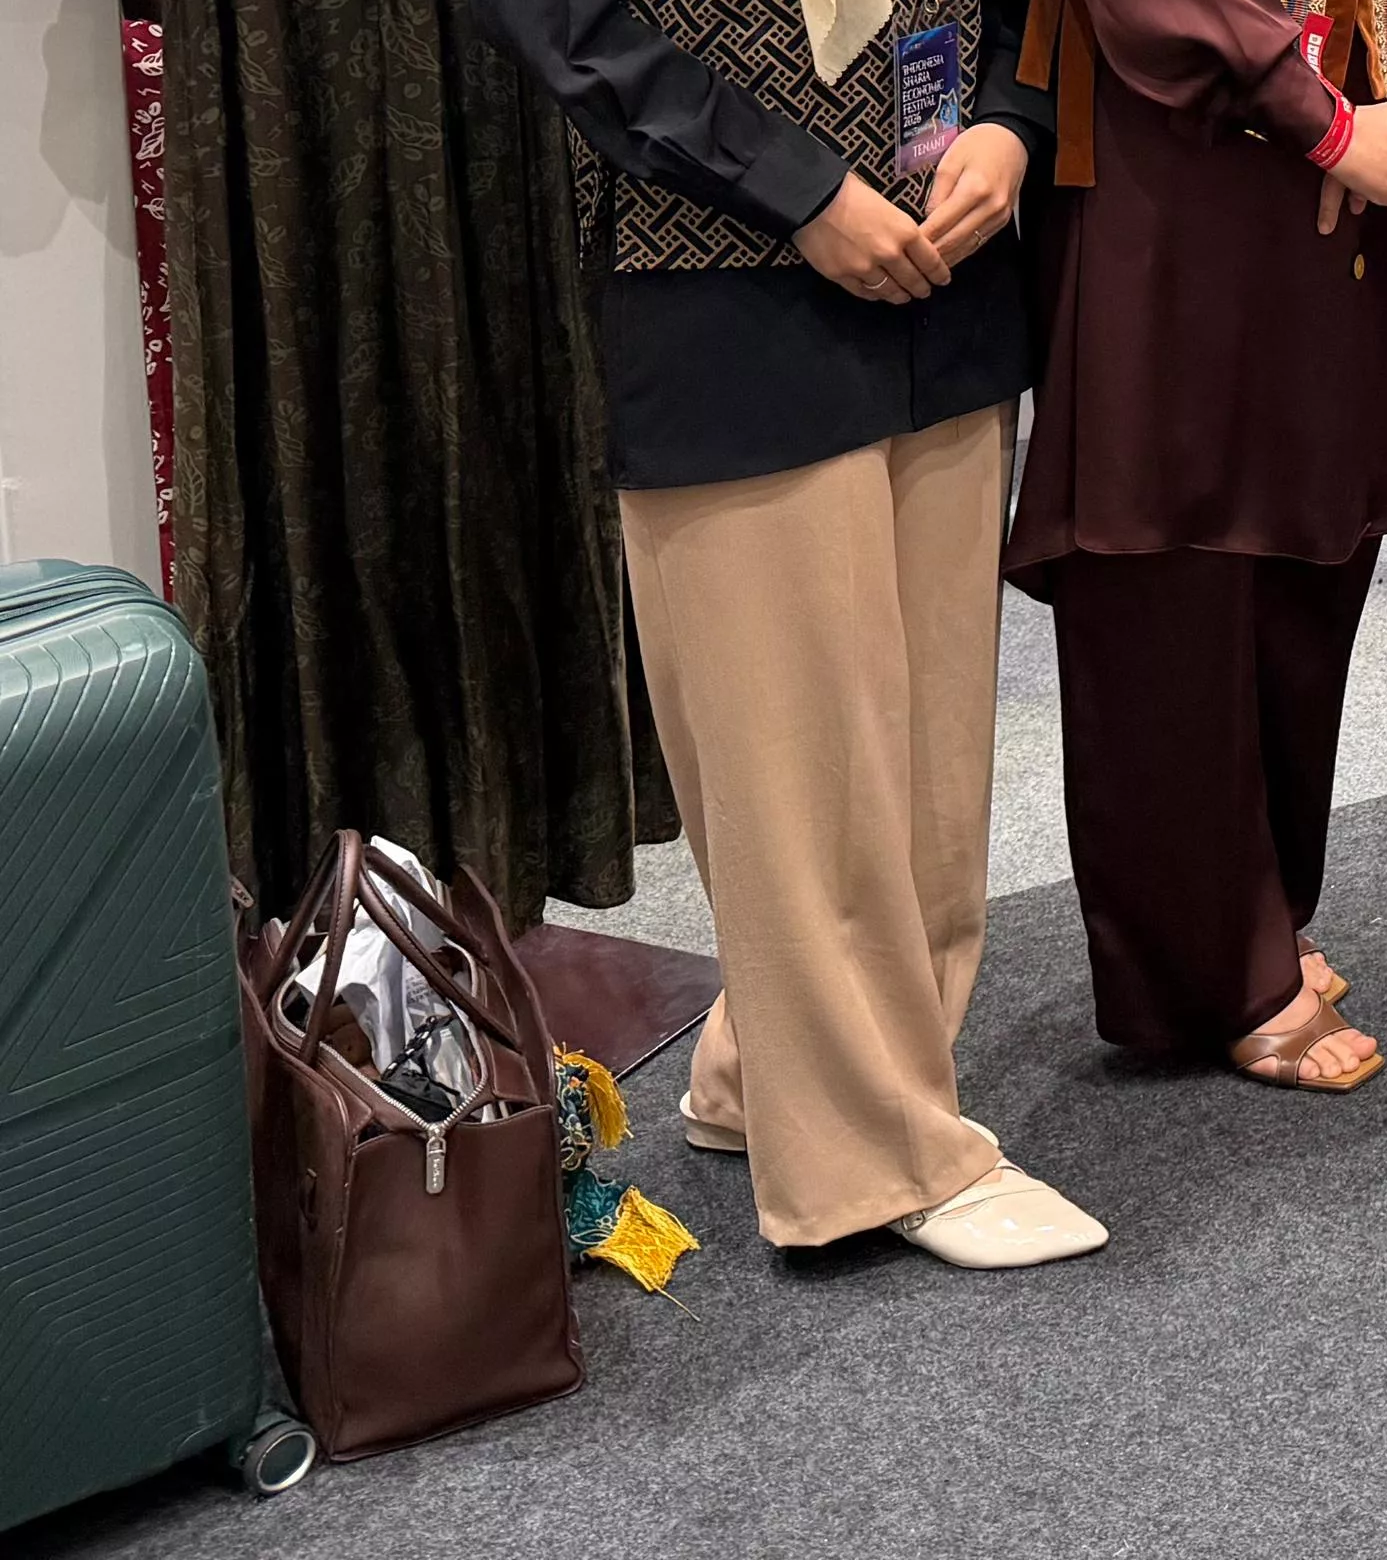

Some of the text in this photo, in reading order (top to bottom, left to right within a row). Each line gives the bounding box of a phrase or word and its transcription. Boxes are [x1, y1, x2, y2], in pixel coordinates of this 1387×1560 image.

[902, 79, 944, 102] ECONOMIC
[903, 95, 936, 116] FESTIVAL
[913, 135, 946, 157] TENANT
